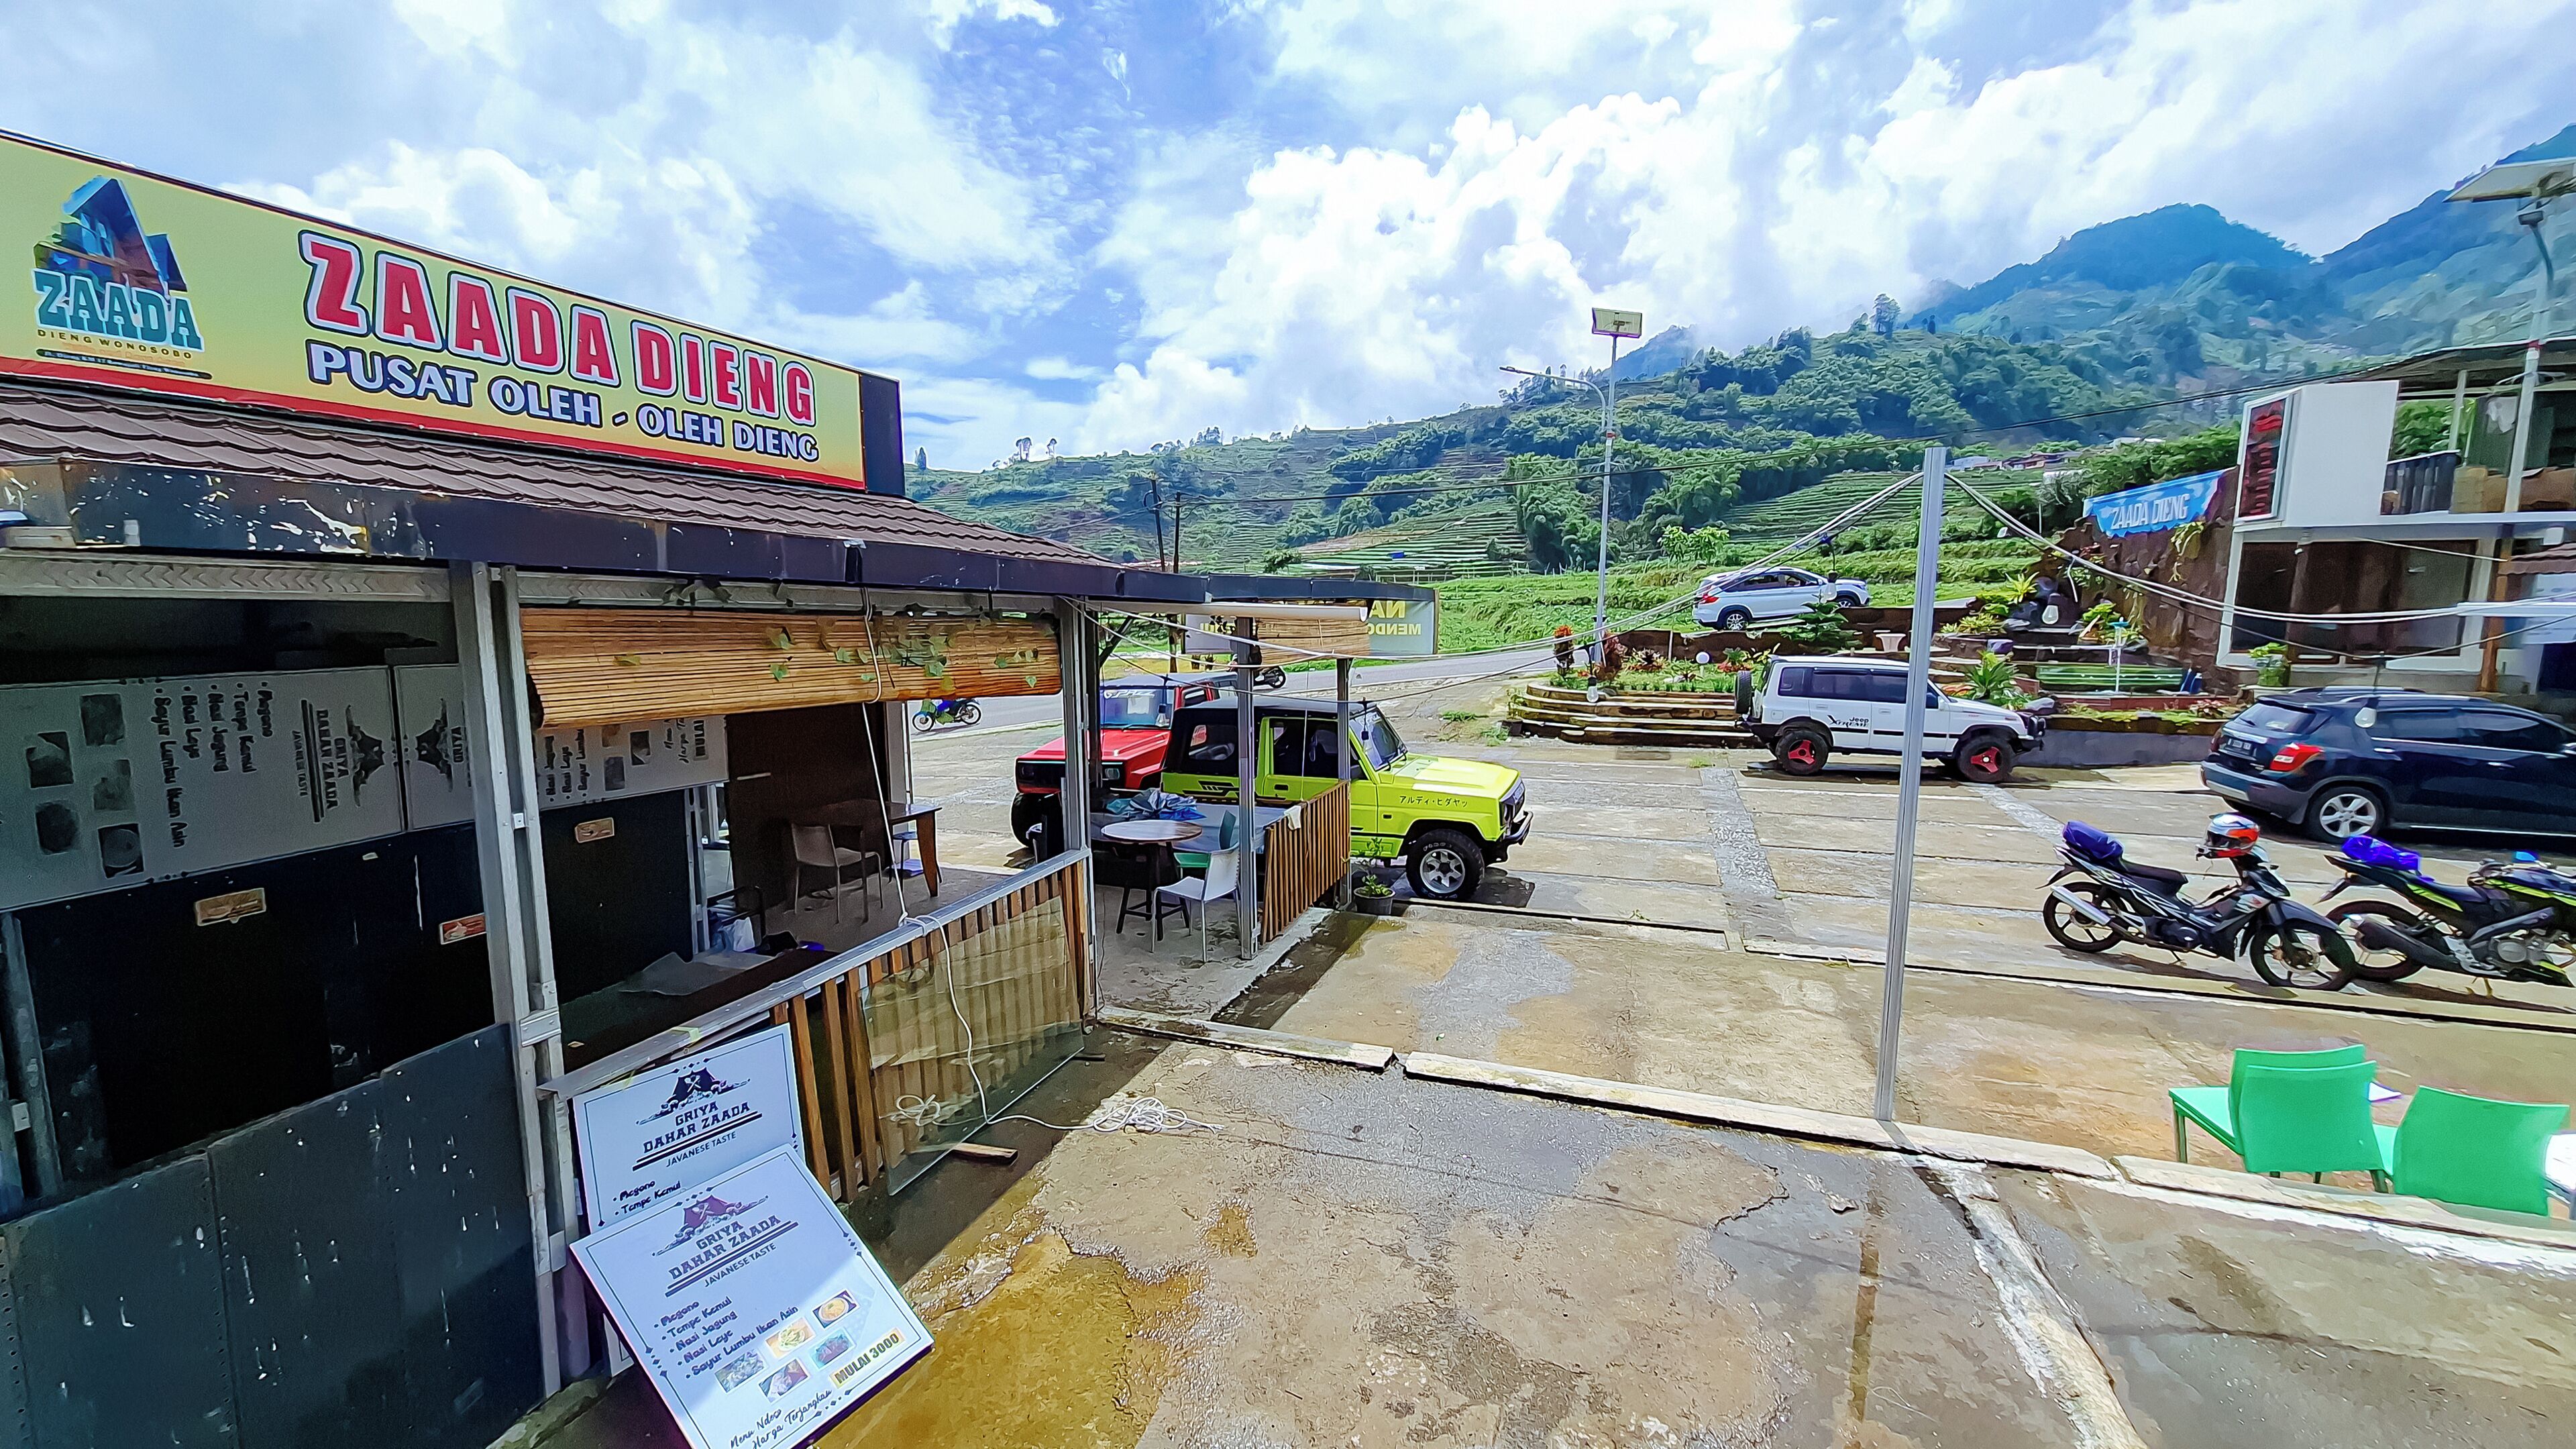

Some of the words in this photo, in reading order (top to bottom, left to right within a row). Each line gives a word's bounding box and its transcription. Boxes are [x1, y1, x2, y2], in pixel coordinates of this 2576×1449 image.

[33, 268, 204, 352] ZAADA
[299, 230, 620, 387] ZAADA
[631, 320, 816, 427] DIENG
[38, 329, 92, 343] DIENG
[99, 338, 192, 359] WONOSOBO
[305, 339, 478, 407] PUSAT
[487, 375, 602, 428] OLEH
[636, 404, 724, 448] OLEH
[733, 422, 820, 462] DIENG
[2110, 502, 2149, 530] ZAADA
[2151, 493, 2191, 524] DIENG
[322, 761, 338, 809] ZAADA
[643, 1123, 696, 1154] DAHAR
[701, 1102, 751, 1130] ZAADA
[675, 1101, 719, 1126] GRIYA
[665, 1142, 710, 1167] JAVANESE
[712, 1131, 737, 1147] TASTE
[621, 1196, 651, 1214] Tempe
[654, 1181, 682, 1199] Kemul
[668, 1244, 727, 1280] DAHAR
[728, 1215, 781, 1248] ZAADA
[696, 1220, 744, 1250] GRIYA
[704, 1256, 750, 1287] JAVANESE
[749, 1242, 777, 1261] TASTE
[666, 1316, 702, 1338] Tempe
[701, 1296, 733, 1318] Kemul
[675, 1332, 700, 1351] Nasi
[702, 1311, 738, 1336] Jagung
[683, 1345, 708, 1364] Nasi
[691, 1352, 723, 1376] Sayur
[723, 1332, 757, 1356] Lumbu
[755, 1318, 780, 1335] Ikan
[780, 1305, 799, 1321] Asin
[834, 1352, 871, 1385] MULAI
[869, 1333, 900, 1359] 3000
[730, 1428, 755, 1449] Menu
[756, 1409, 782, 1429] Ndeso
[751, 1424, 784, 1449] Harga
[784, 1389, 833, 1424] Terjangkau
